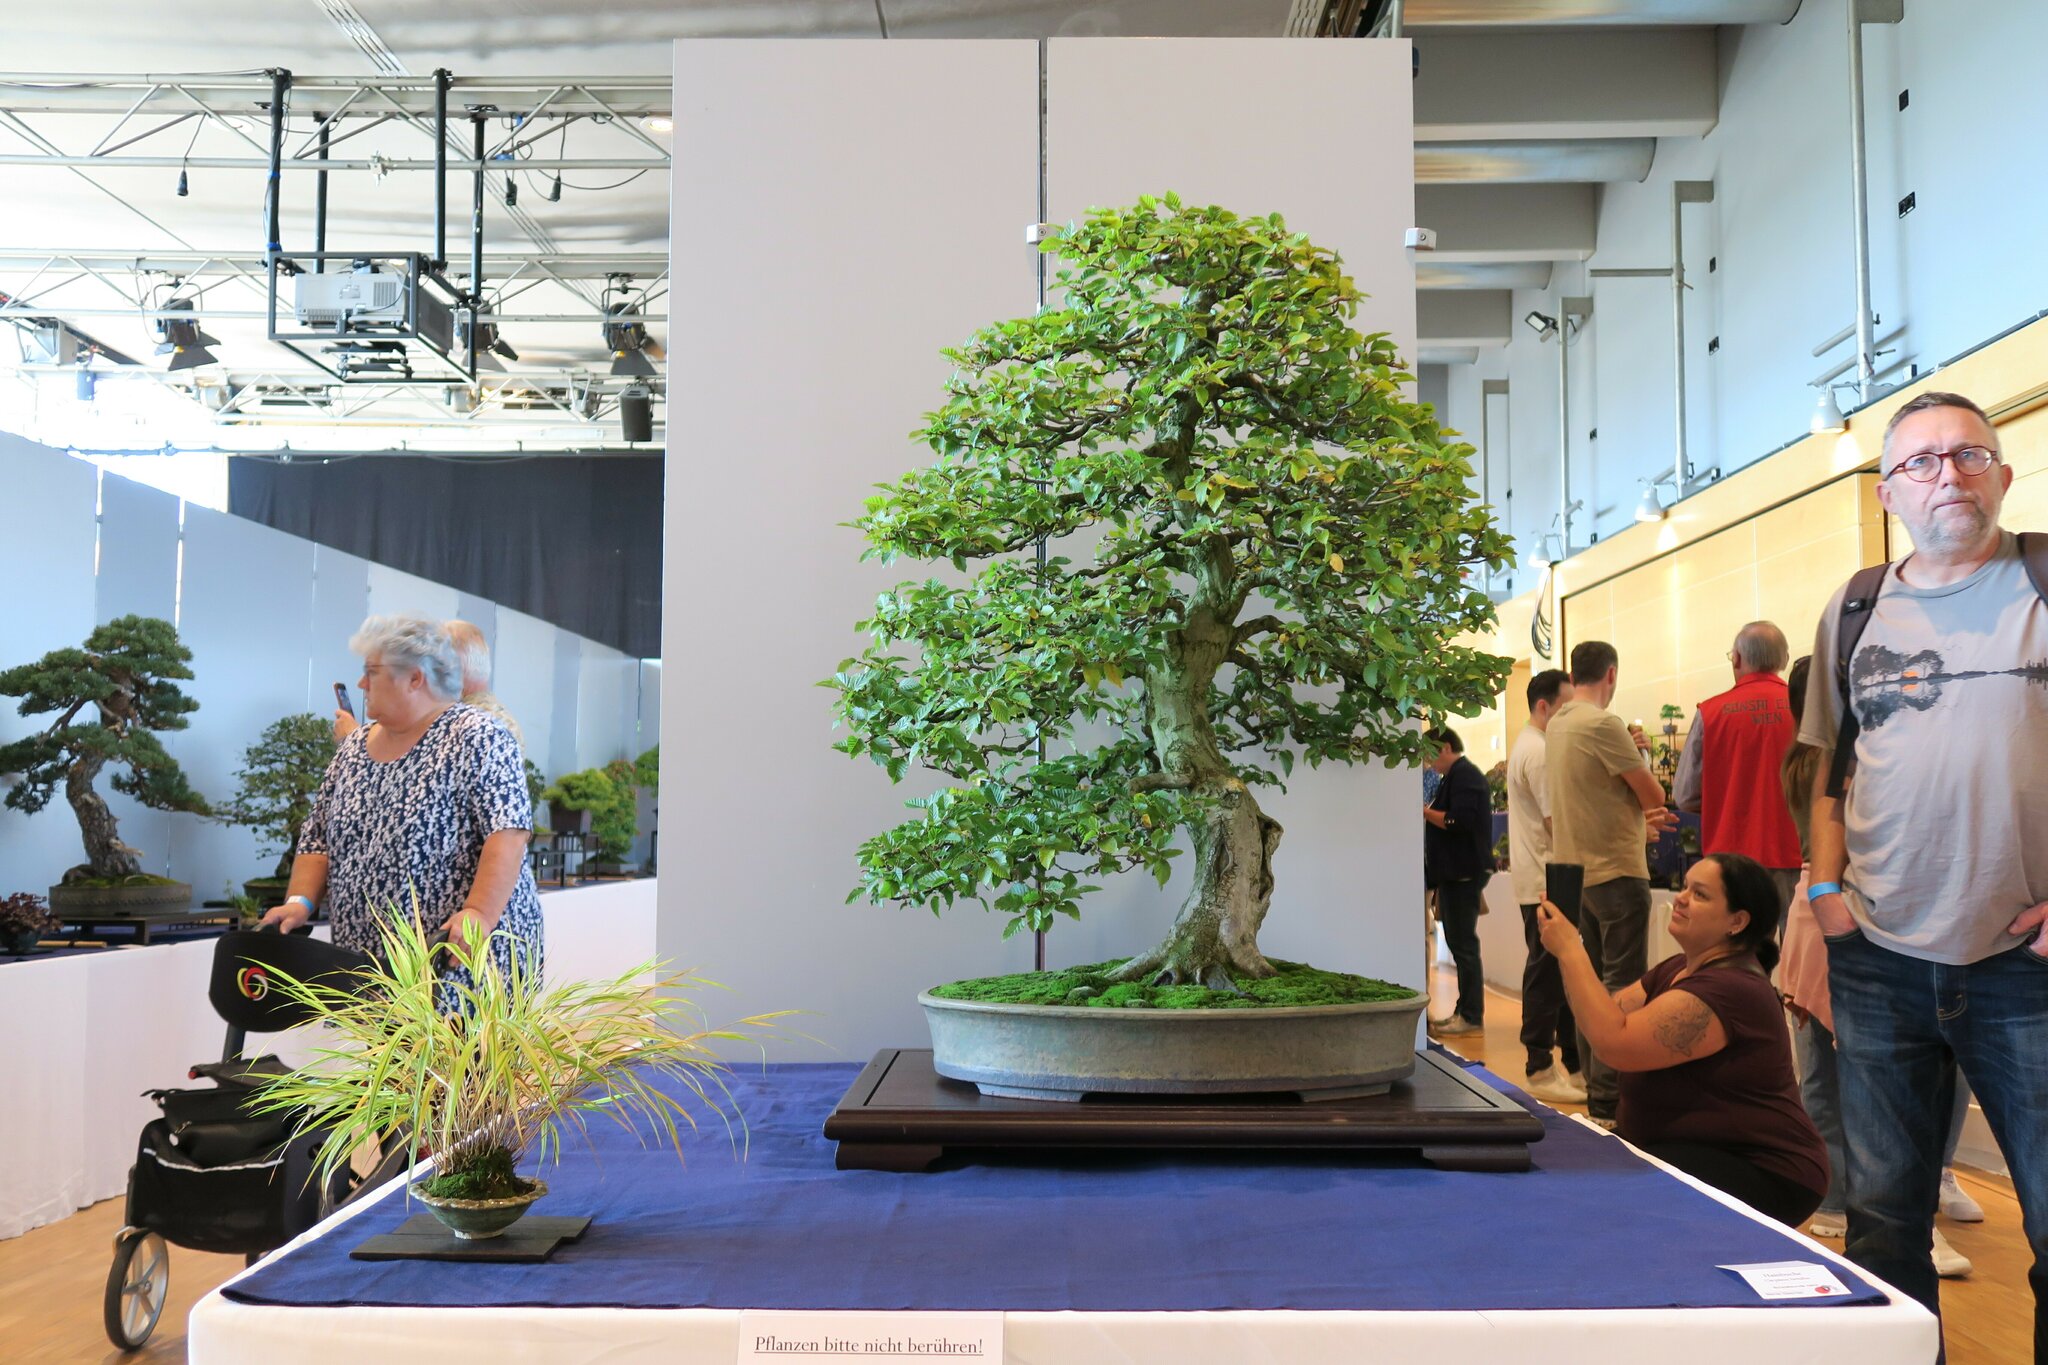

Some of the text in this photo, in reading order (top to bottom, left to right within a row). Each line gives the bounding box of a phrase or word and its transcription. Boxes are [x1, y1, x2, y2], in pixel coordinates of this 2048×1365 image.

[1751, 711, 1782, 724] WIEN
[755, 1336, 983, 1354] Pflanzen bitte nicht berühren!
